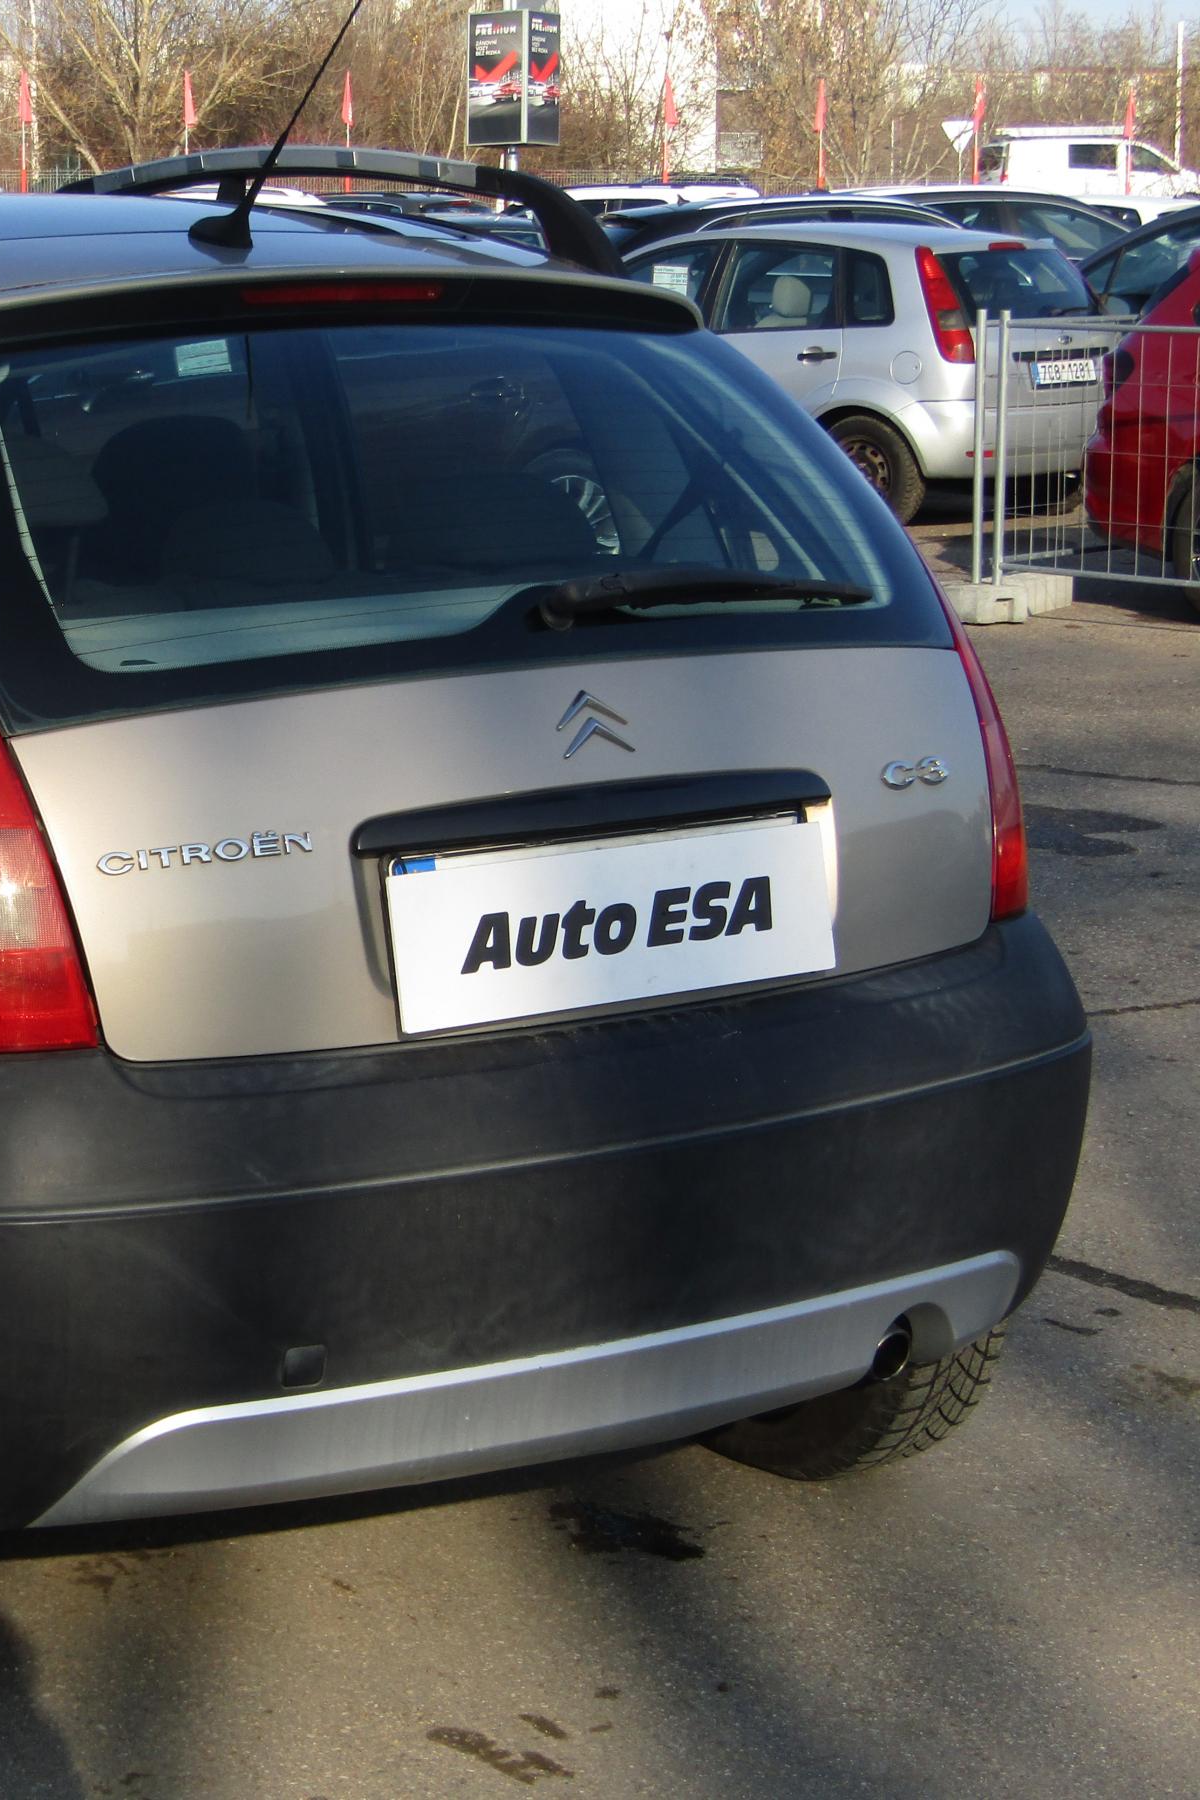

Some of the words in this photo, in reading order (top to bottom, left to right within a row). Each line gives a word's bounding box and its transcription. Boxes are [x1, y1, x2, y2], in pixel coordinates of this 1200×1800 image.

[881, 755, 950, 791] C3
[96, 830, 313, 876] CITROËN
[461, 900, 638, 975] Auto
[647, 875, 773, 948] ESA
